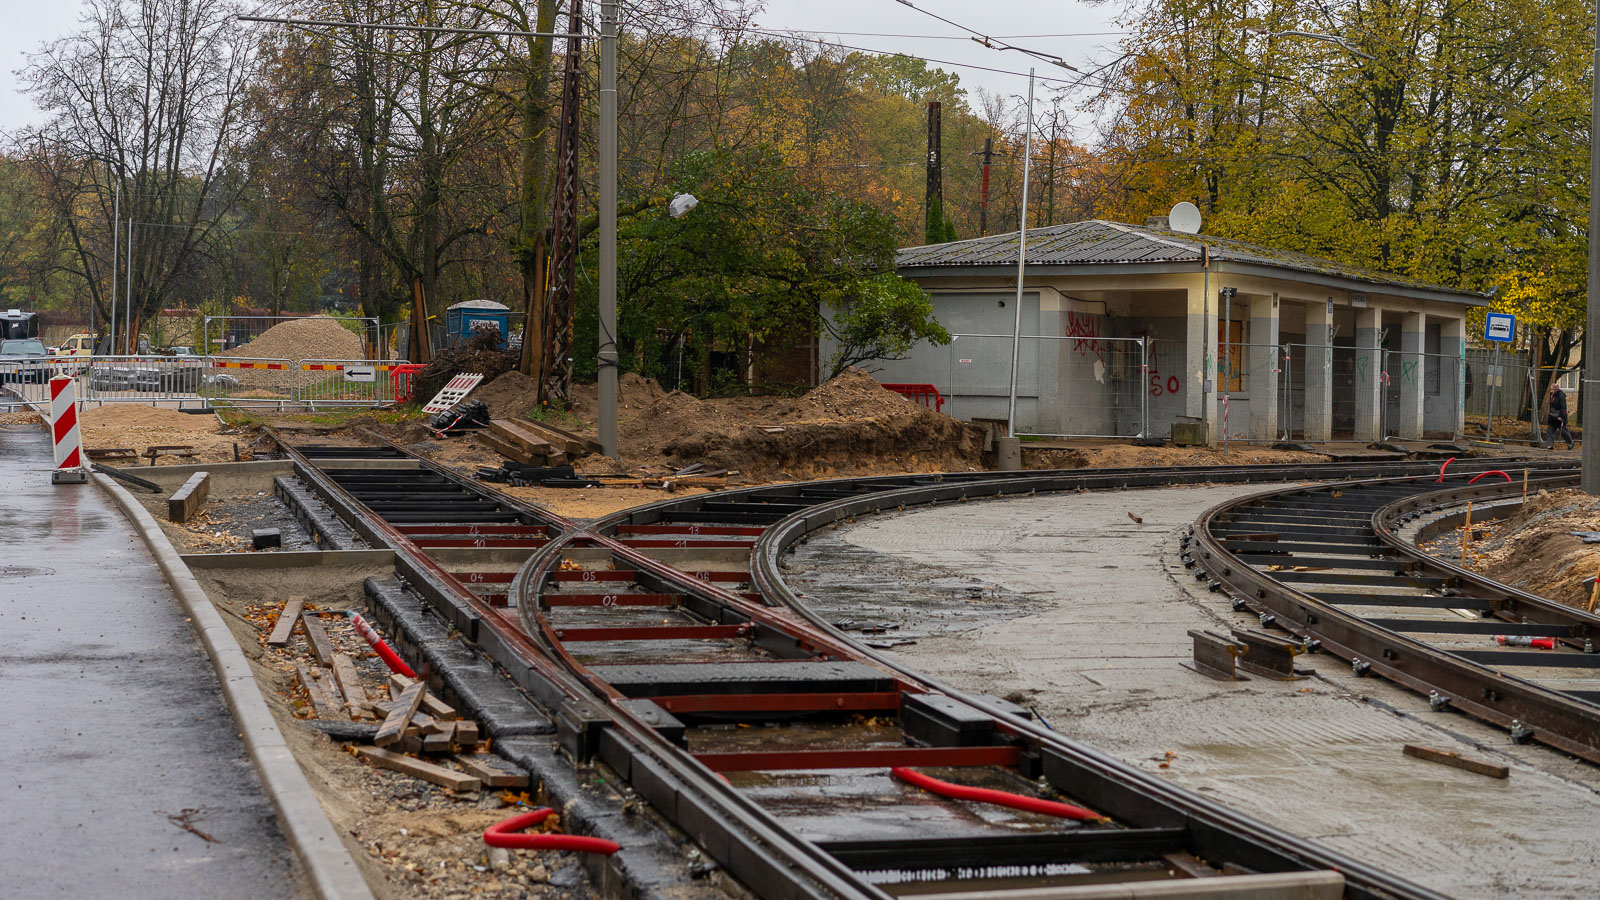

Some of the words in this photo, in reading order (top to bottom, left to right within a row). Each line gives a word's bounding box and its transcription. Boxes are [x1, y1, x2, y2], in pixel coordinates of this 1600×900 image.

[688, 526, 699, 535] 13
[473, 539, 486, 548] 10
[675, 539, 687, 549] 11
[470, 573, 484, 582] 04
[582, 571, 596, 581] 05
[695, 569, 710, 580] 06
[602, 594, 618, 607] 02
